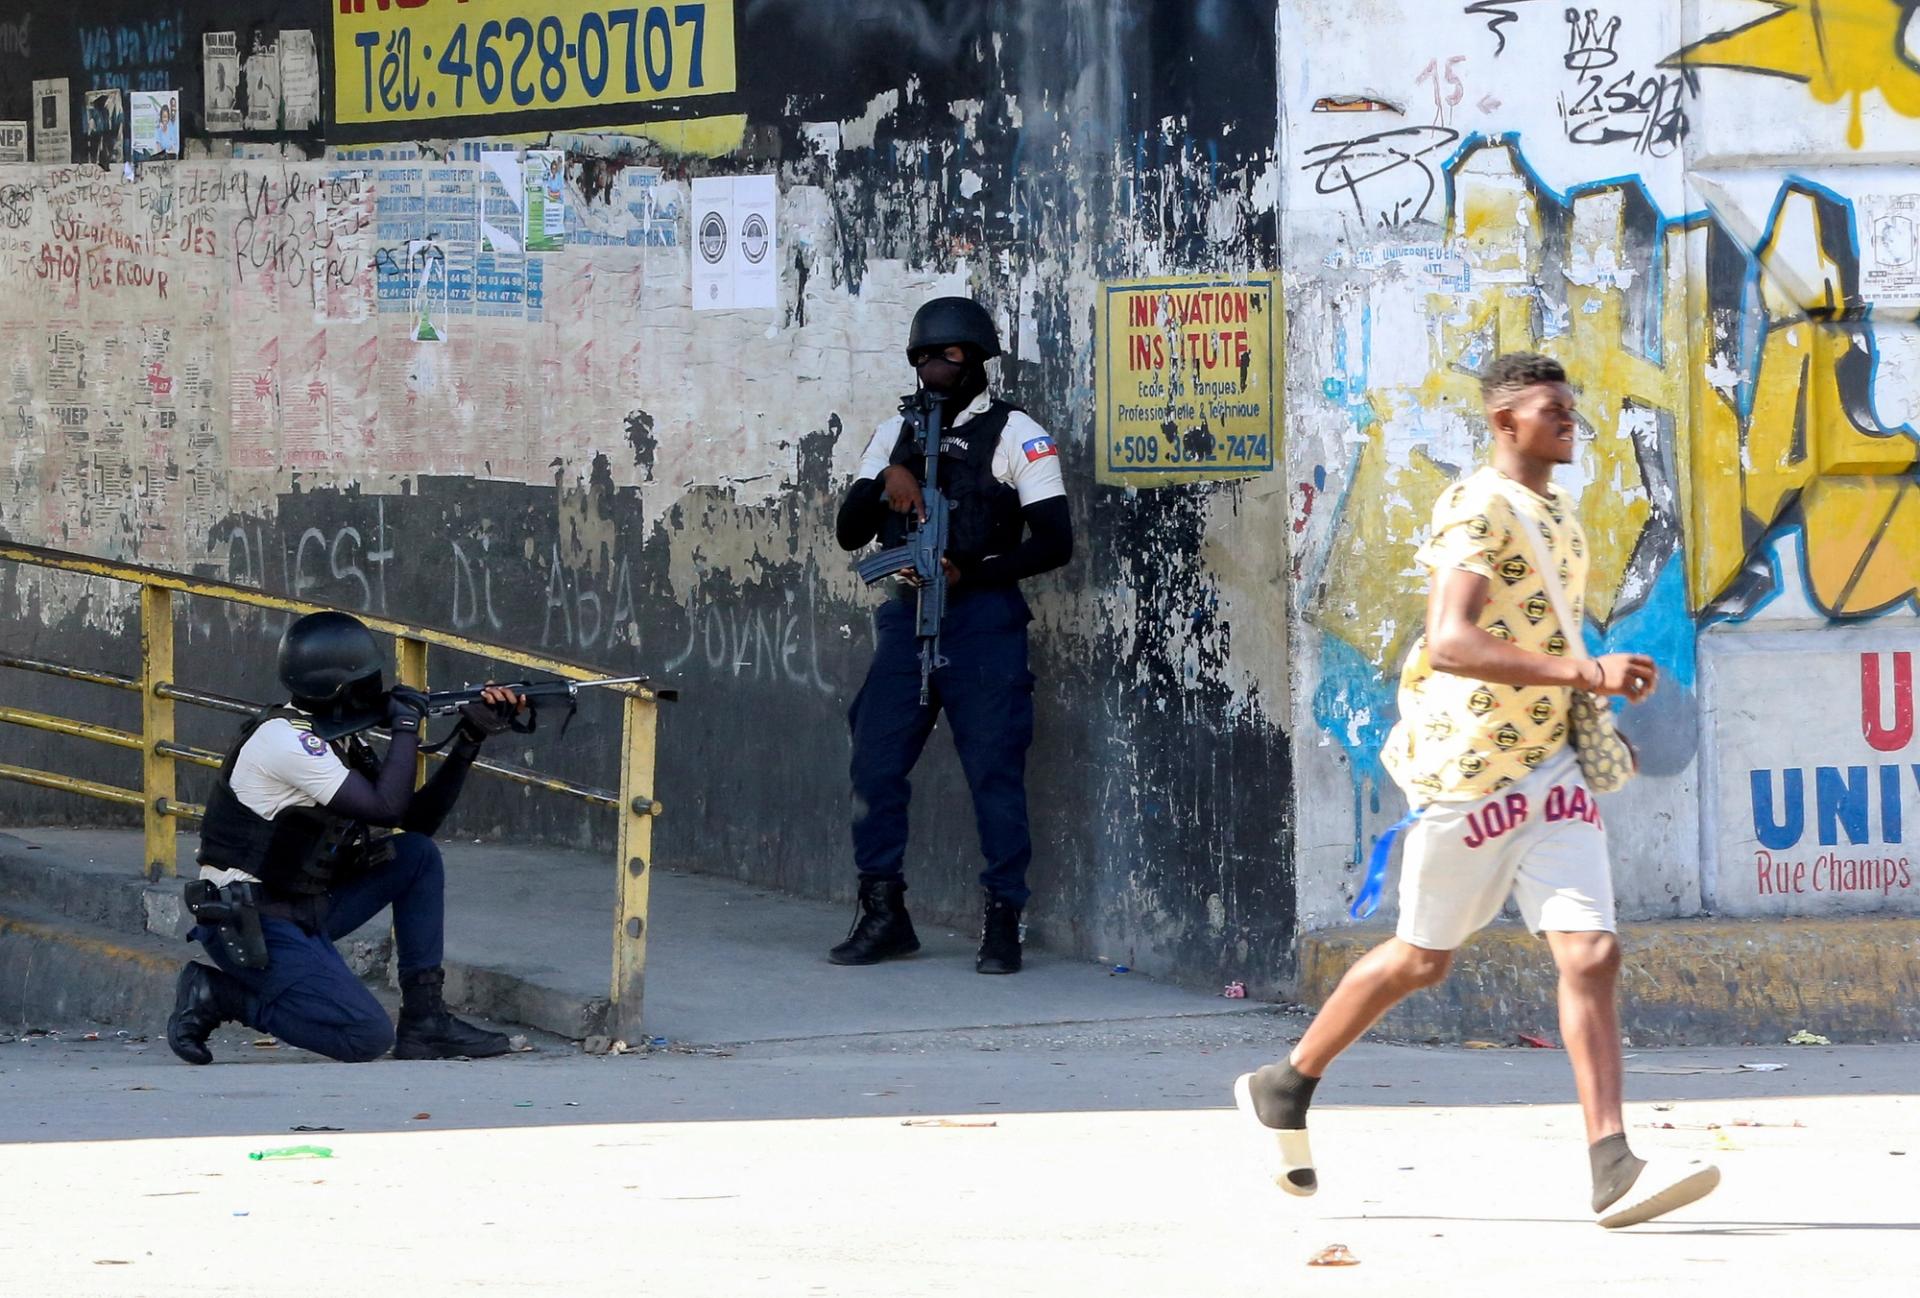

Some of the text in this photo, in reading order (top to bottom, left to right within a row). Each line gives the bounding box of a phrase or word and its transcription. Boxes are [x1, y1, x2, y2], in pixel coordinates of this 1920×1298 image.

[1115, 434, 1158, 464] +509
[1754, 850, 1912, 896] Rue Champs
